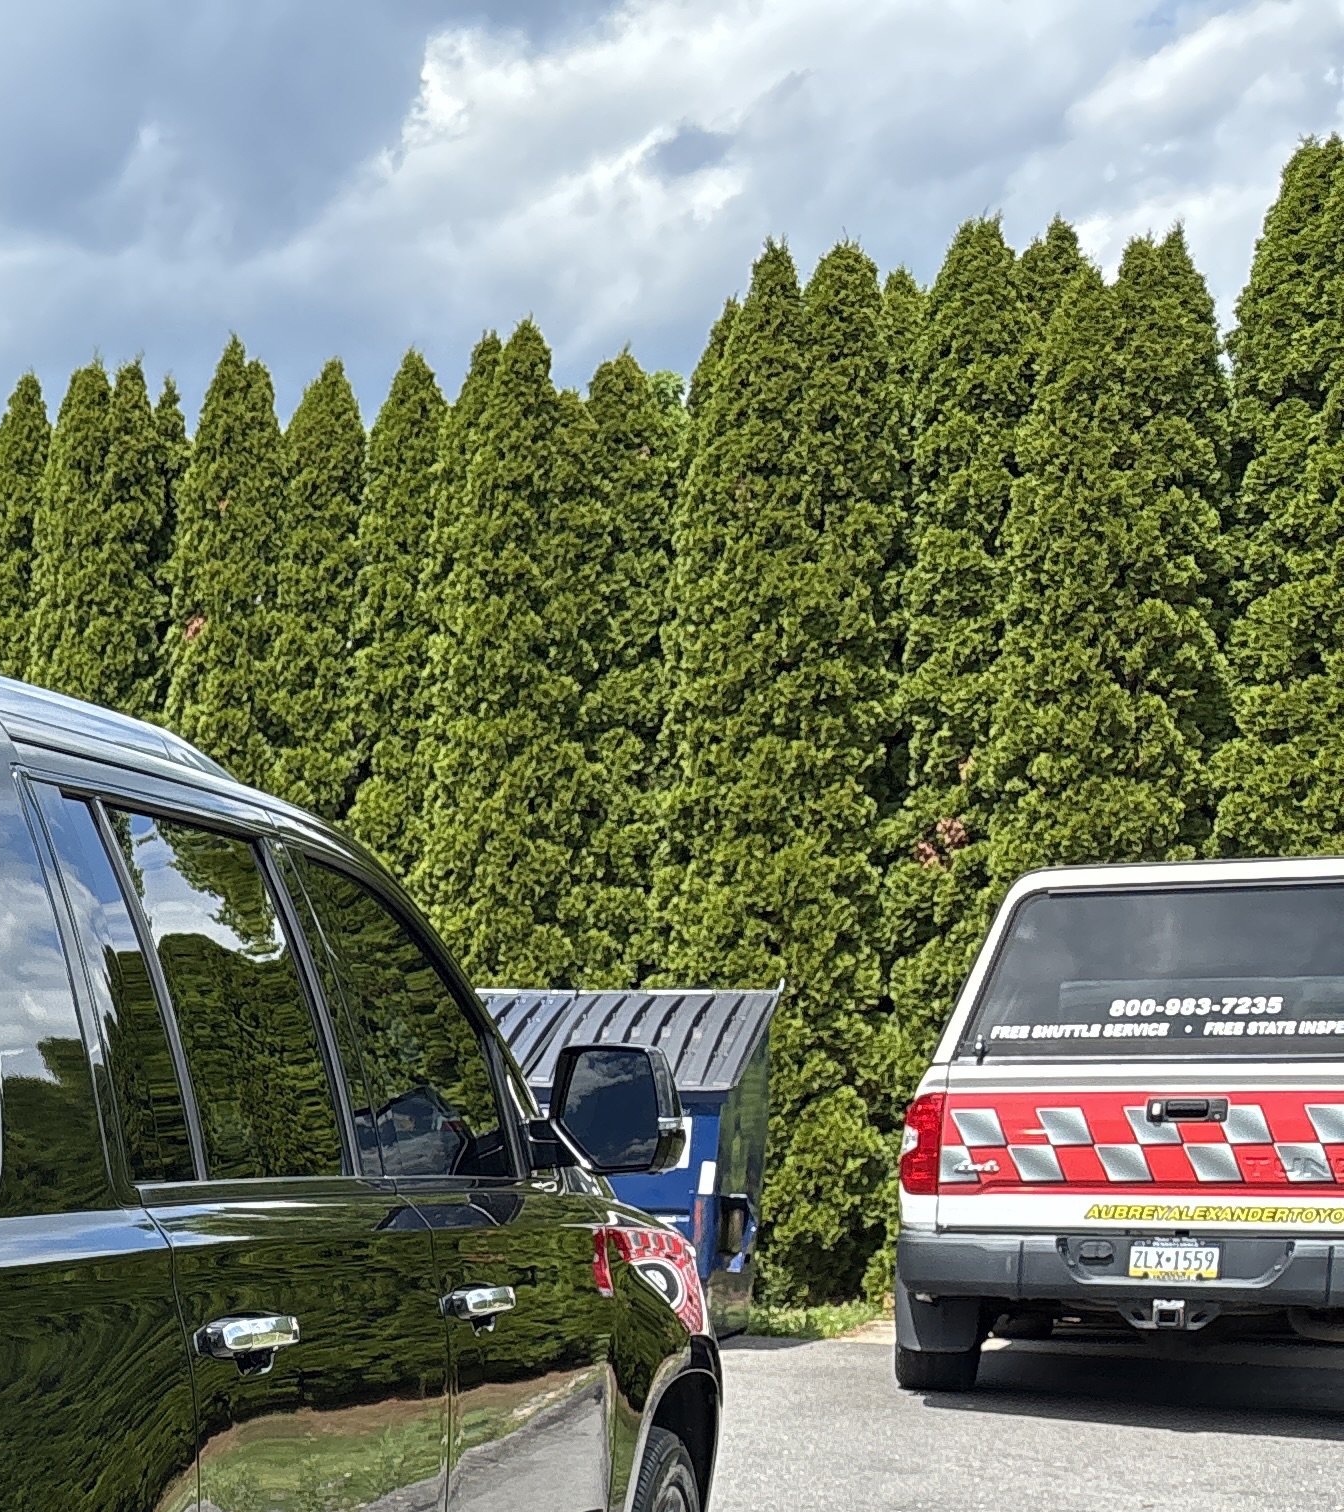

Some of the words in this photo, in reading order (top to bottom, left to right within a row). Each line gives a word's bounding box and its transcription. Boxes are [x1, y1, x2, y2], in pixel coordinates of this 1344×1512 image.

[1109, 996, 1283, 1017] 800-983-7235
[990, 1025, 1031, 1040] FREE
[1032, 1023, 1102, 1038] SHUTTLE
[1103, 1022, 1170, 1037] SERVICE
[1203, 1021, 1245, 1036] FREE
[1246, 1020, 1297, 1035] STATE
[1085, 1204, 1344, 1224] AUBREYALEXANDERTOYO
